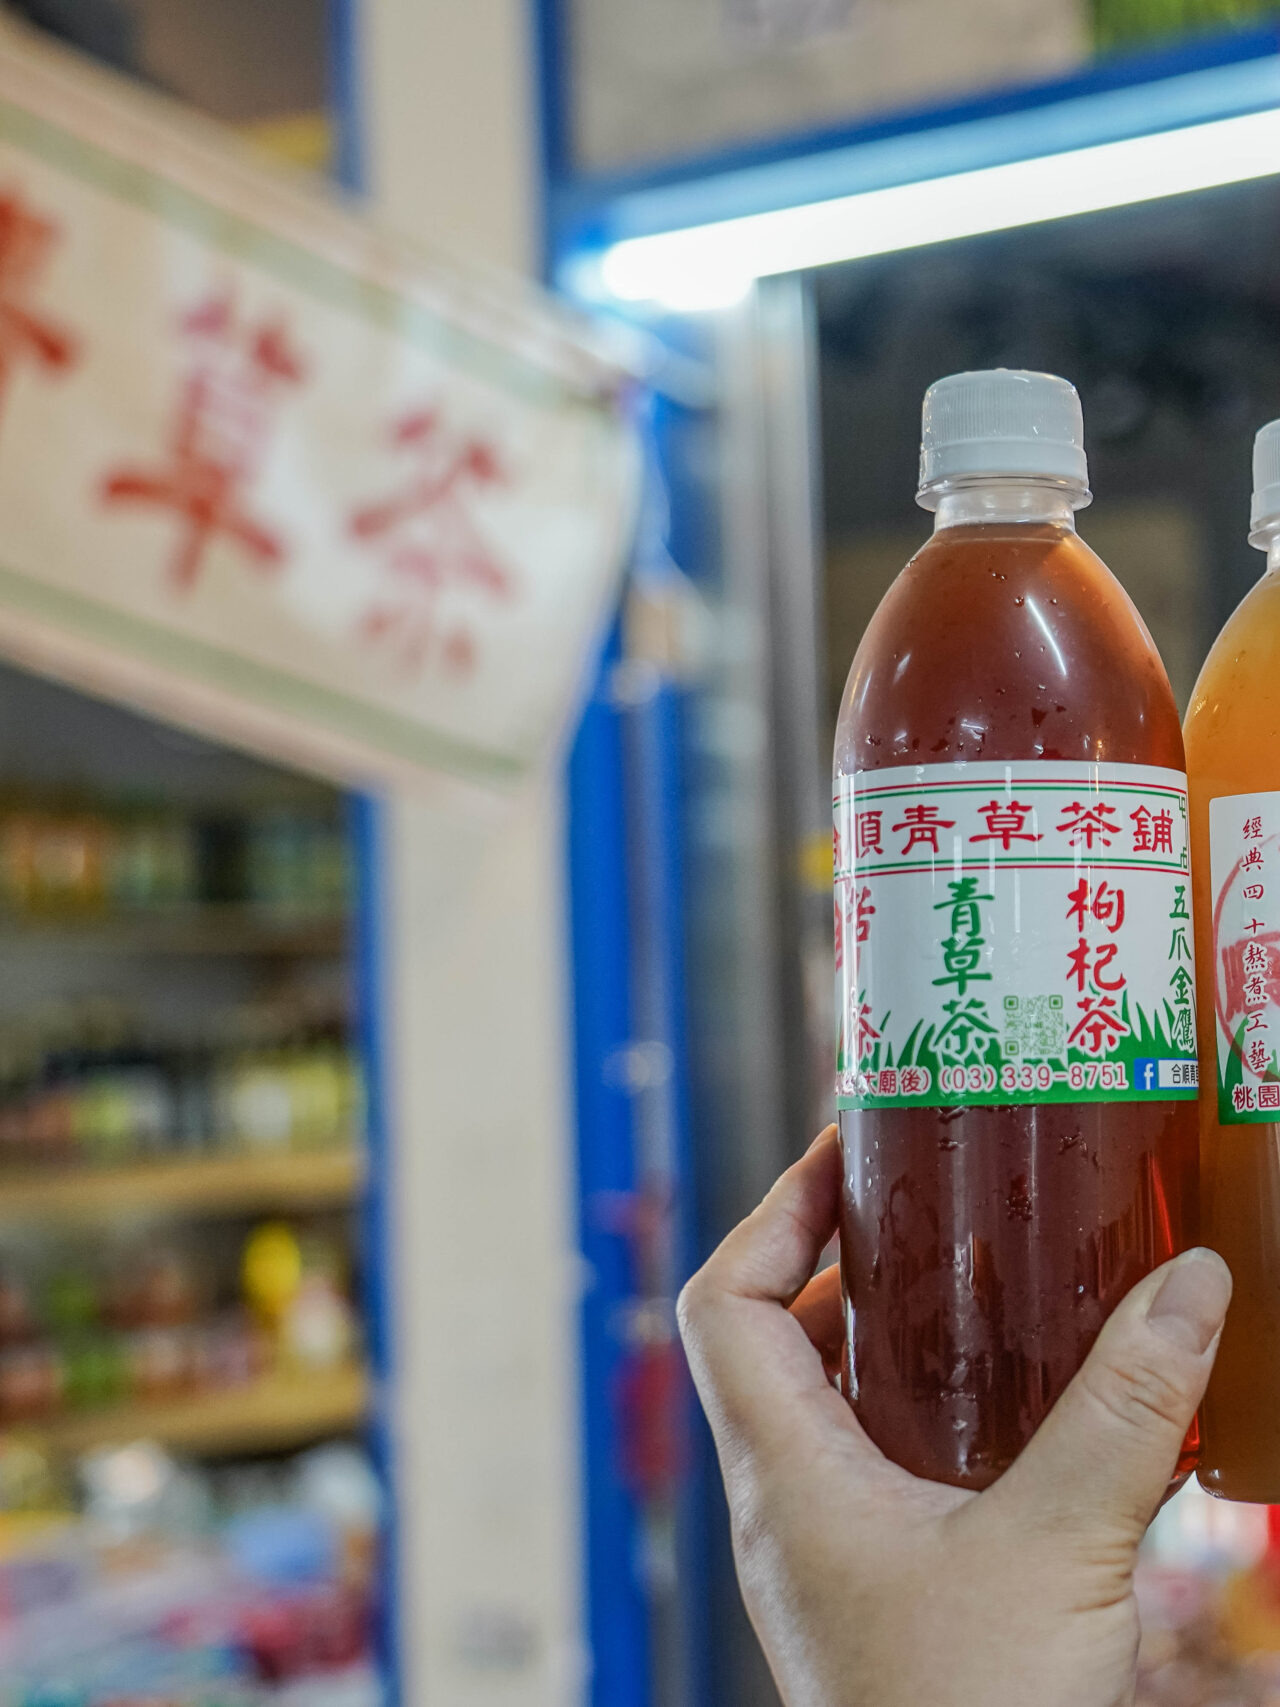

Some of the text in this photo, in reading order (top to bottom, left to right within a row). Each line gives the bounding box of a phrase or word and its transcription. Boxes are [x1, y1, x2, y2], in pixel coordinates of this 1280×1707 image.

[834, 800, 1174, 857] 順青草茶鋪
[932, 877, 999, 1055] 青草茶
[1065, 878, 1128, 1053] 枸杞茶
[1242, 816, 1272, 1071] 經典四十熬煮工藝
